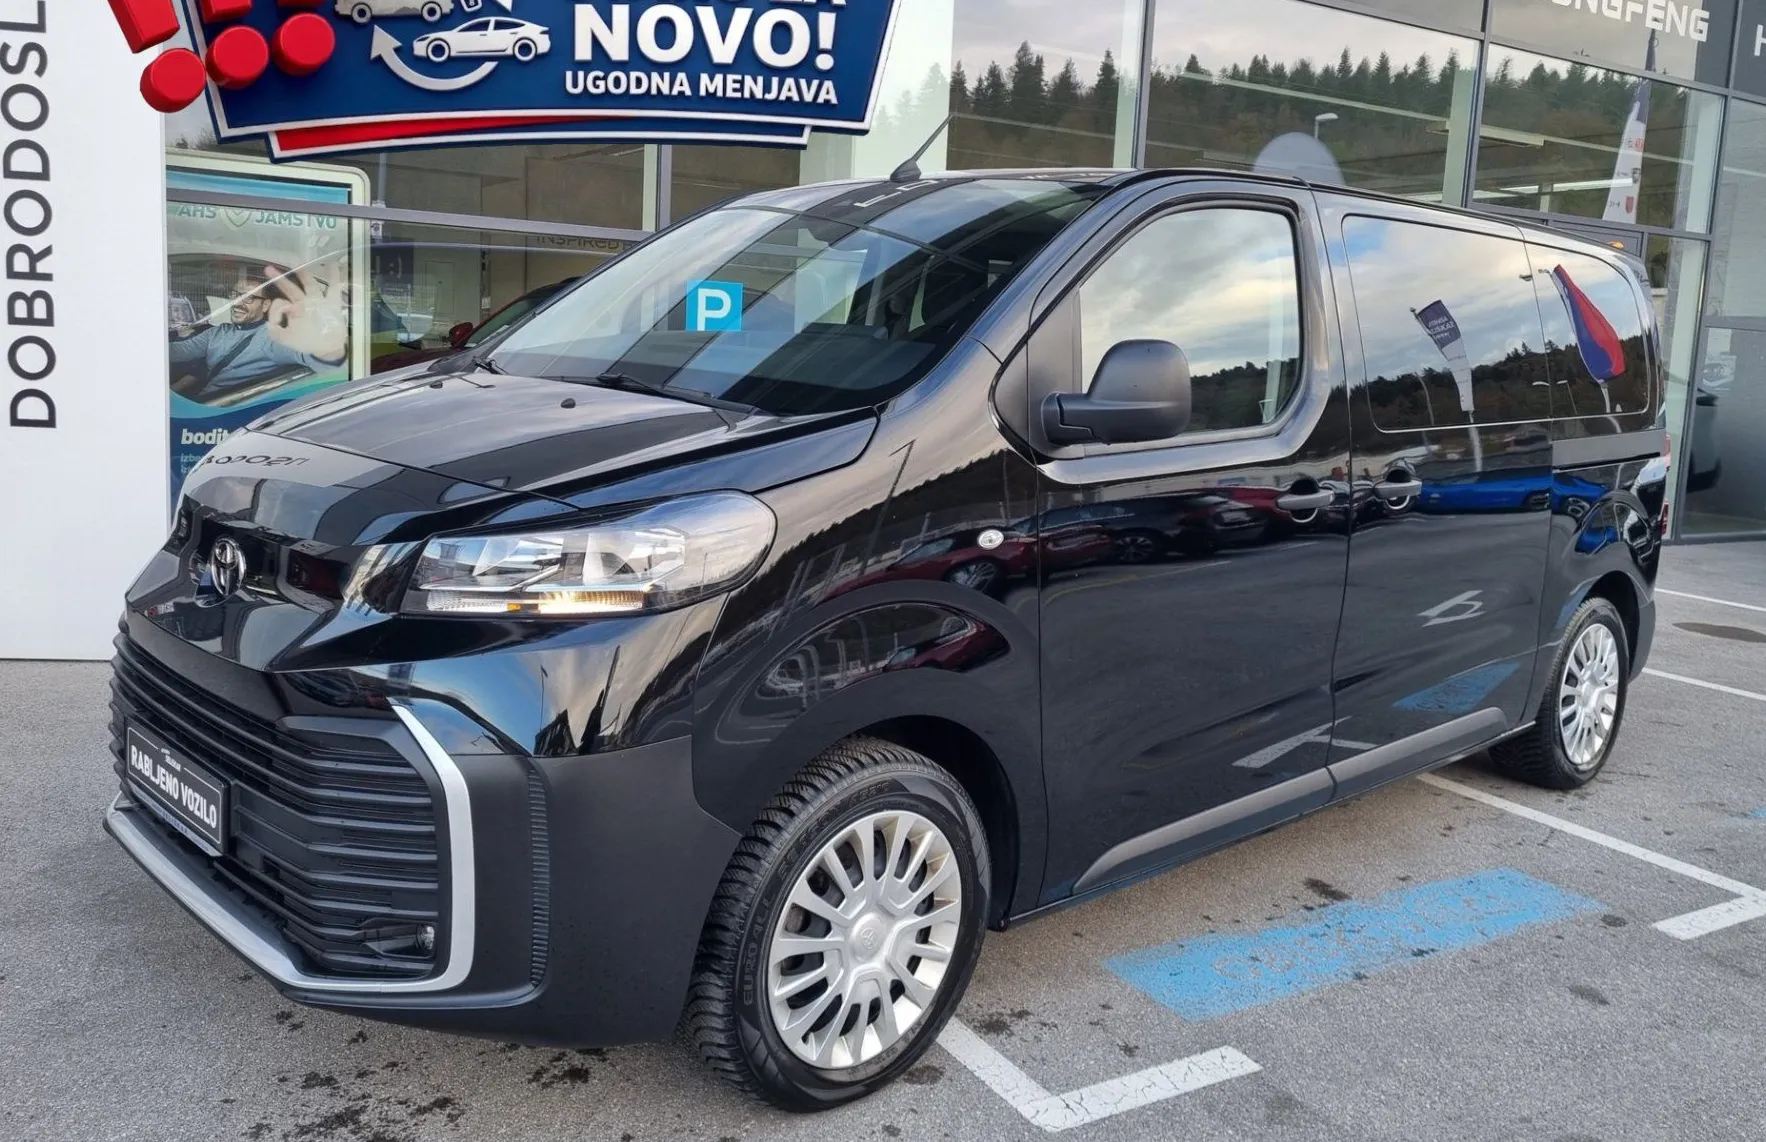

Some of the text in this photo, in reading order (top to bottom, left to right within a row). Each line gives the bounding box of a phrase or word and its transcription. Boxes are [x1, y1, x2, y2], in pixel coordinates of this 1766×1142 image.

[696, 288, 732, 332] P
[131, 744, 180, 800] RABLJENO
[180, 782, 217, 829] VOZILO
